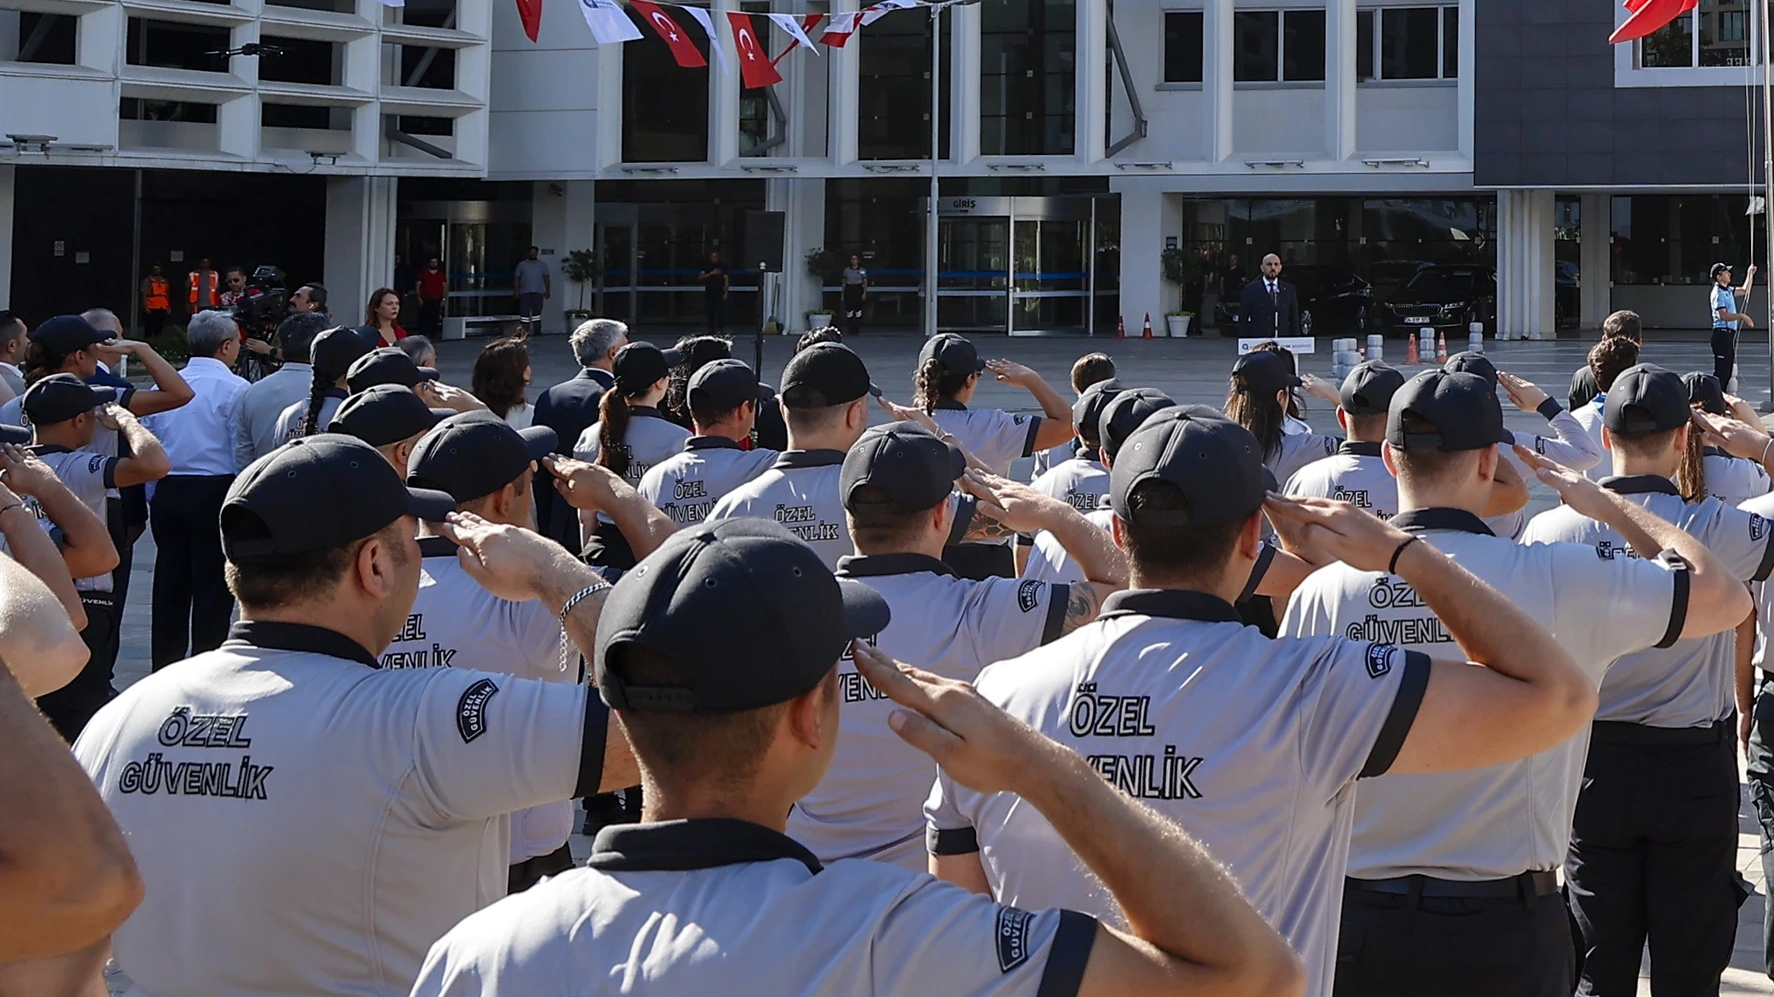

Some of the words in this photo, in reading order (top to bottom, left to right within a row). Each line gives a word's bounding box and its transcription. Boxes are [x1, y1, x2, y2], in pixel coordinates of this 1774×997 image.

[953, 198, 976, 209] GİRİŞ
[674, 477, 707, 500] ÖZEL
[1066, 487, 1099, 510] ÖZEL
[1334, 485, 1373, 508] ÖZEL
[773, 503, 816, 523] ÖZEL
[789, 521, 839, 542] ENLİK
[392, 614, 426, 642] EL
[1346, 614, 1457, 645] GÜVENL
[1069, 682, 1155, 737] ÖZEL
[158, 706, 253, 749] ÖZEL
[120, 753, 274, 800] GÜVENLİK
[1086, 745, 1204, 800] ENLİK
